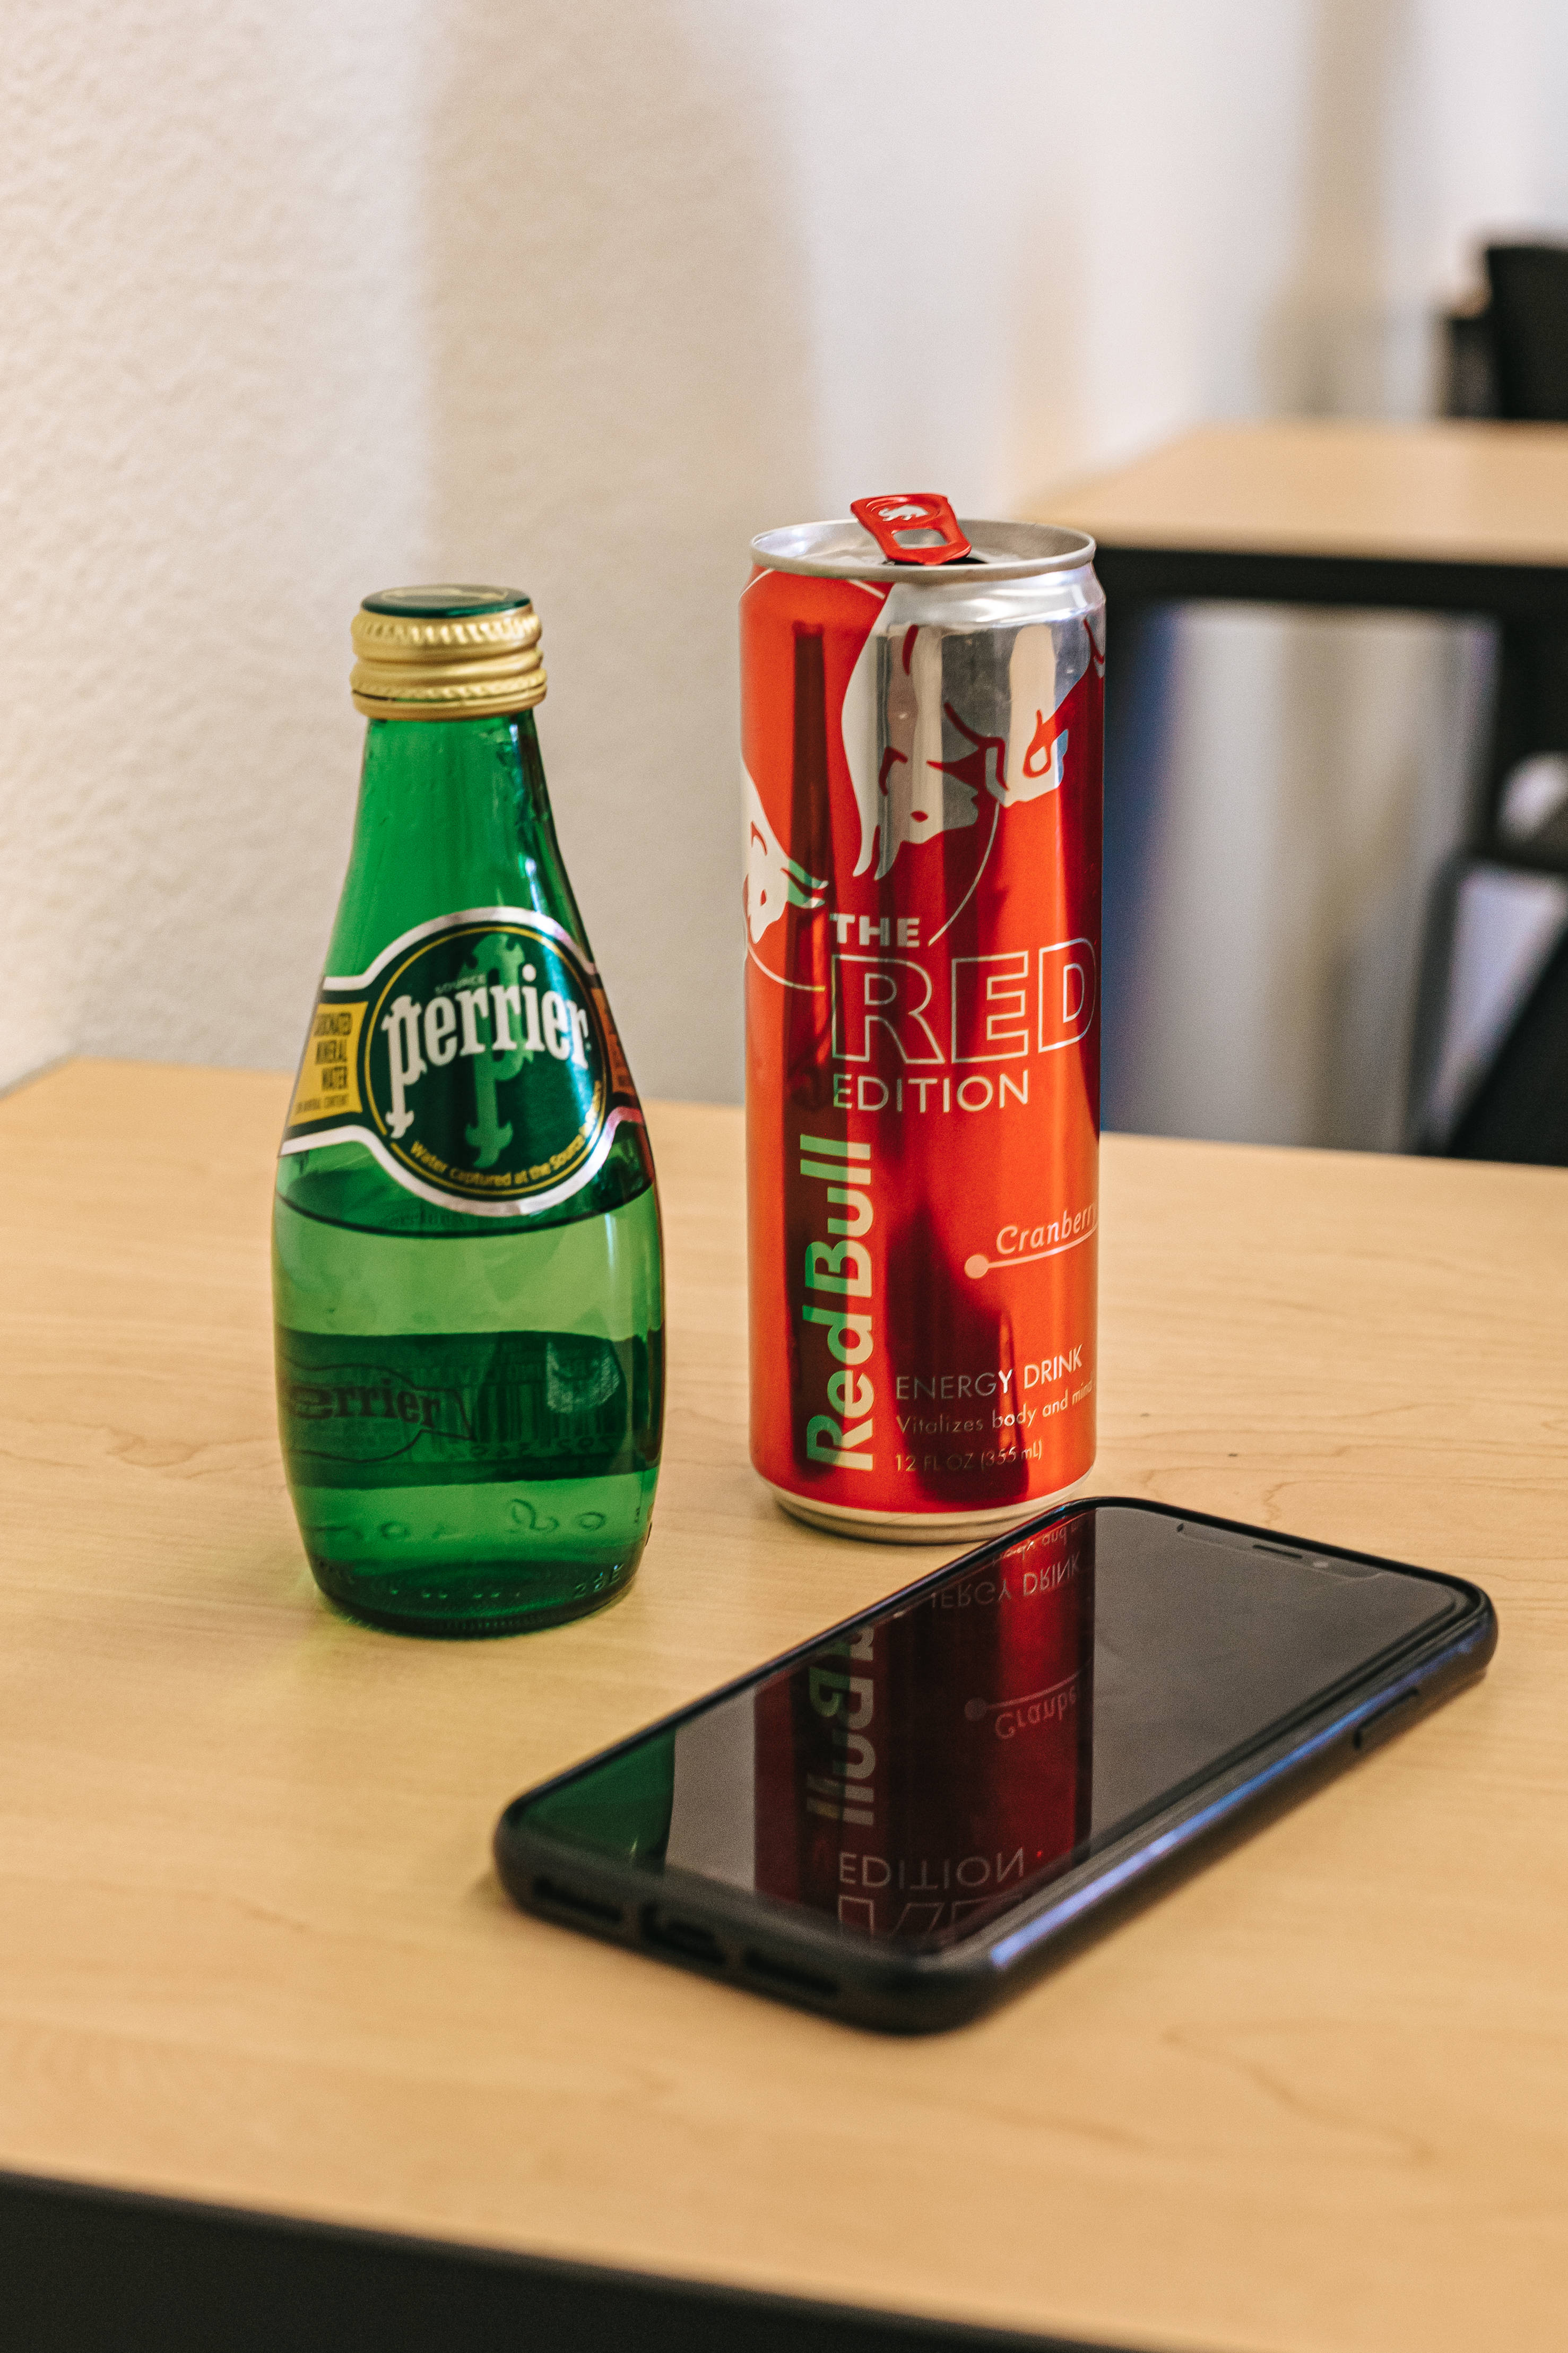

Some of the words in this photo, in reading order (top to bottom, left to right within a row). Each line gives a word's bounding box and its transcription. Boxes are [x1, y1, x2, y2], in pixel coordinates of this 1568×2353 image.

[829, 913, 921, 947] THE
[831, 938, 1097, 1064] RED
[833, 1070, 1029, 1114] EDITION
[896, 1369, 1014, 1400] ENERGY
[1023, 1343, 1083, 1389] DRINK
[896, 1413, 983, 1434] Vitalizes
[992, 1402, 1037, 1428] body
[1042, 1388, 1069, 1417] and
[895, 1454, 917, 1472] 12
[923, 1454, 939, 1472] FL
